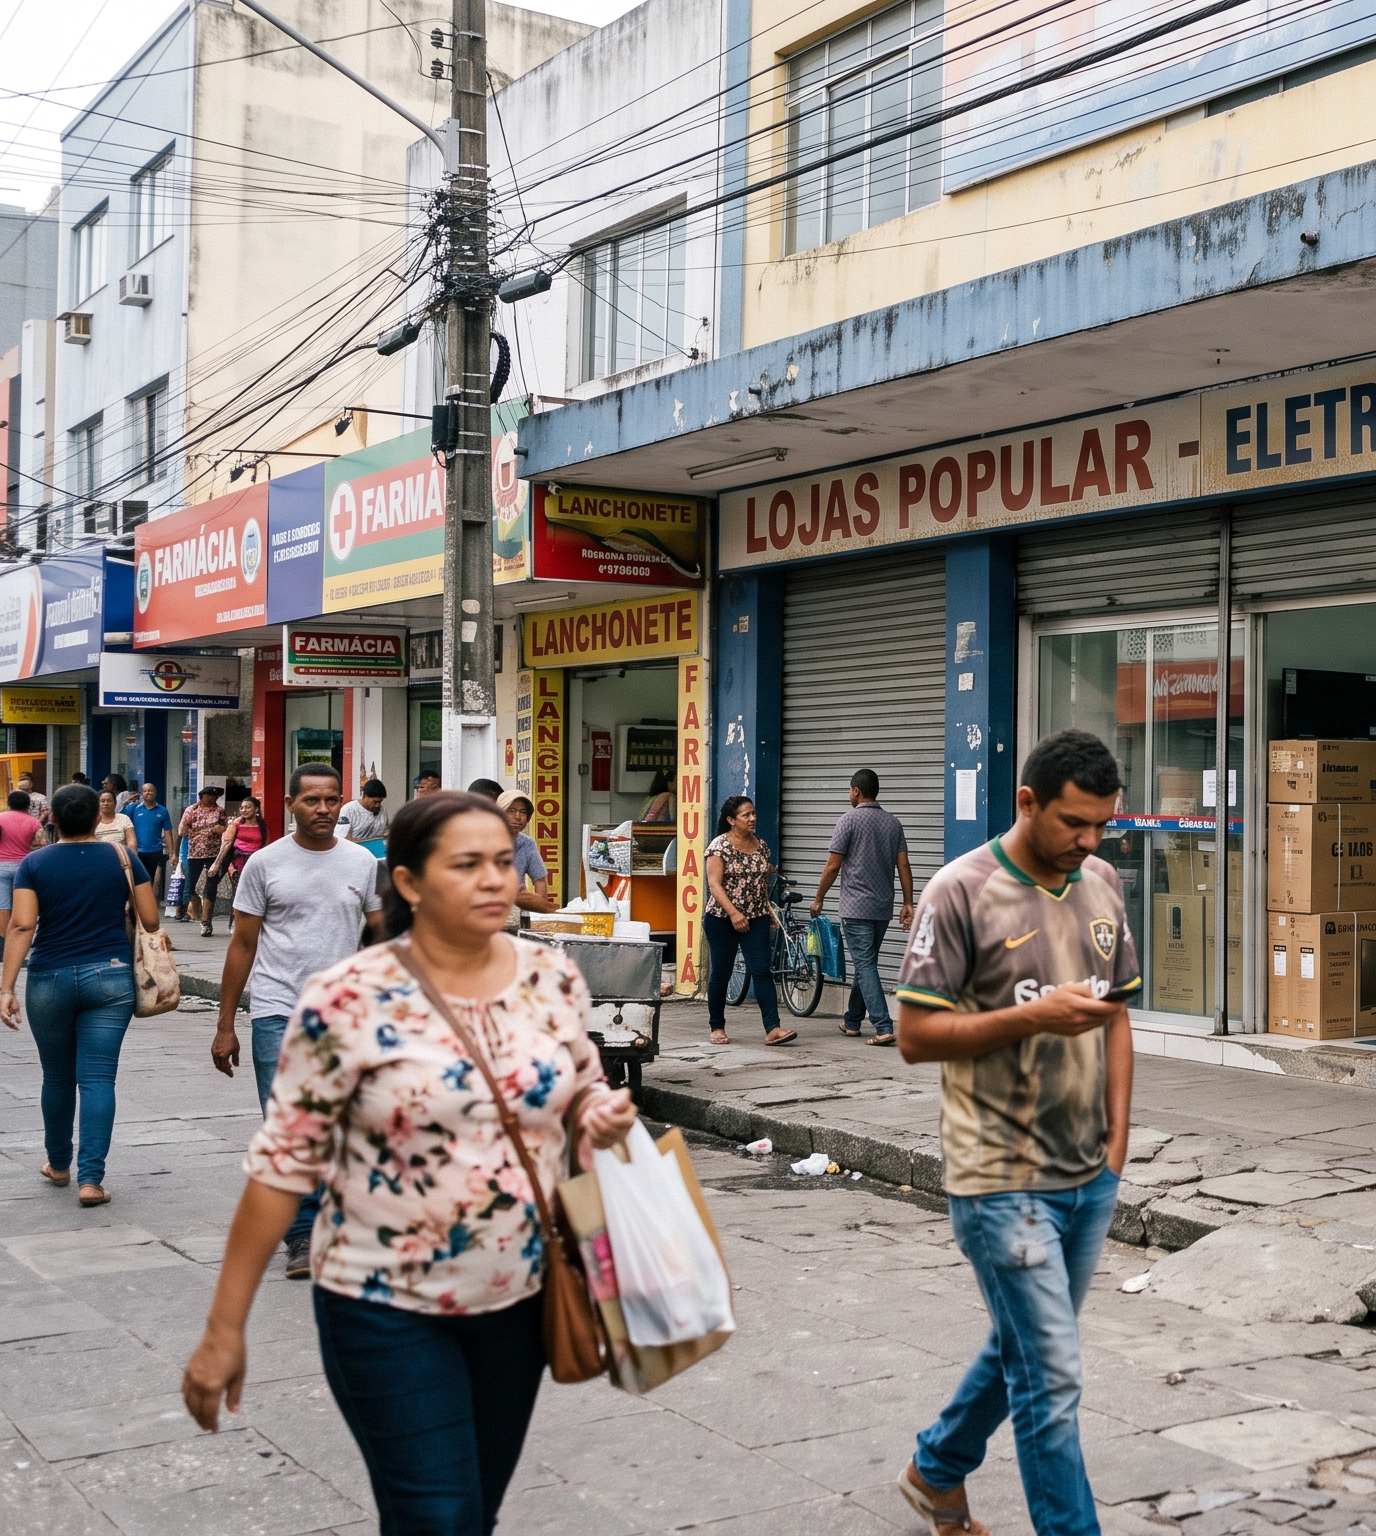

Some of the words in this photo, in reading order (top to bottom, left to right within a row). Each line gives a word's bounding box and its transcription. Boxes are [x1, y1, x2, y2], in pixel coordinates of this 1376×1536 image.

[362, 457, 446, 535] FARMÁ
[558, 495, 692, 524] LANCHONETE
[746, 471, 880, 554] LOJAS
[899, 419, 1154, 530] POPULAR
[154, 524, 237, 588] FARMÁCIA
[294, 636, 396, 654] FARMÁCIA
[531, 599, 692, 657] LANCHONETE
